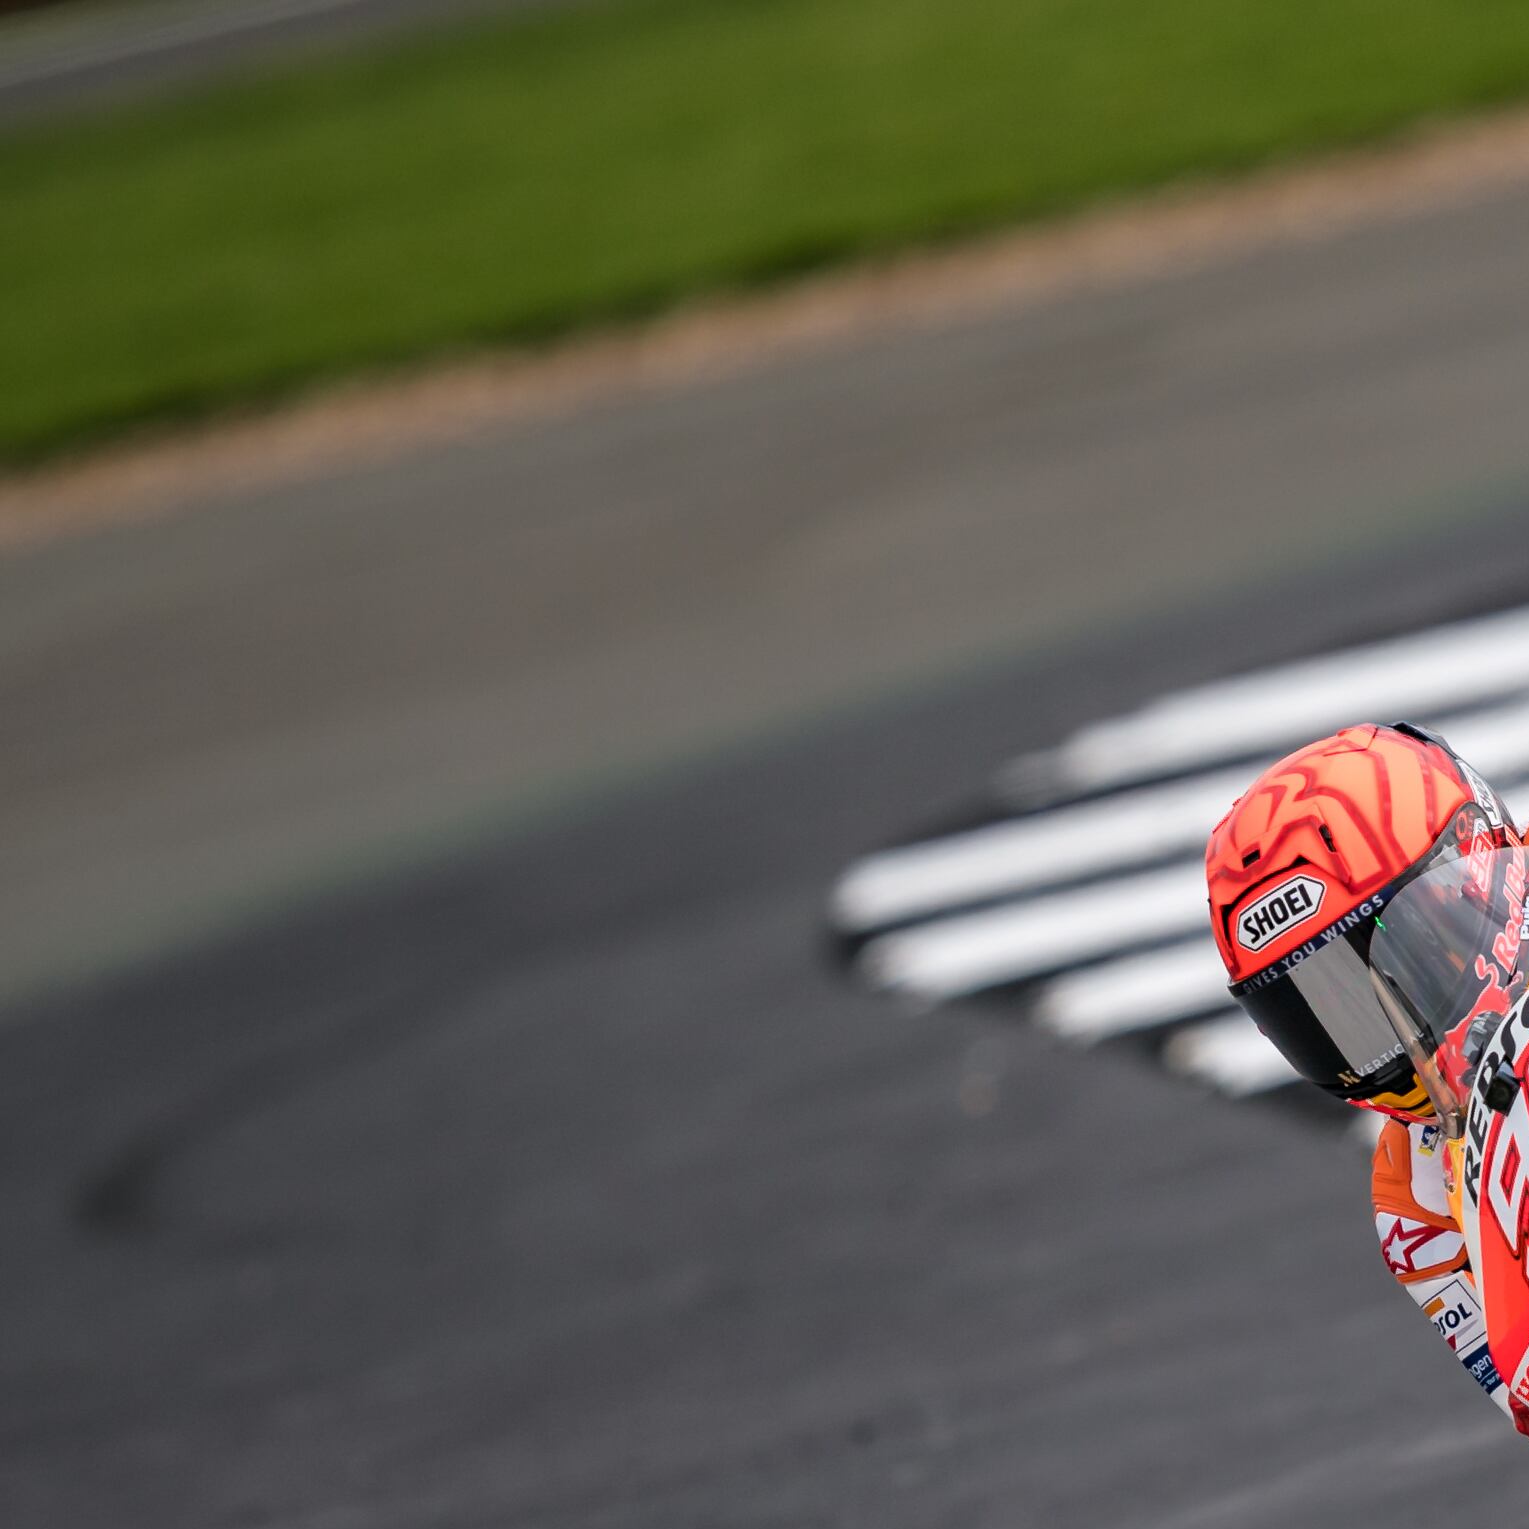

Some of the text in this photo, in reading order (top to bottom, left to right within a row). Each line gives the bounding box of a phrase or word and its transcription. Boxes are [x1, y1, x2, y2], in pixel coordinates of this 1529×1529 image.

[1242, 883, 1315, 941] SHOEI
[1243, 894, 1384, 995] GIVES YOU WINGS
[1434, 1301, 1473, 1337] SOL
